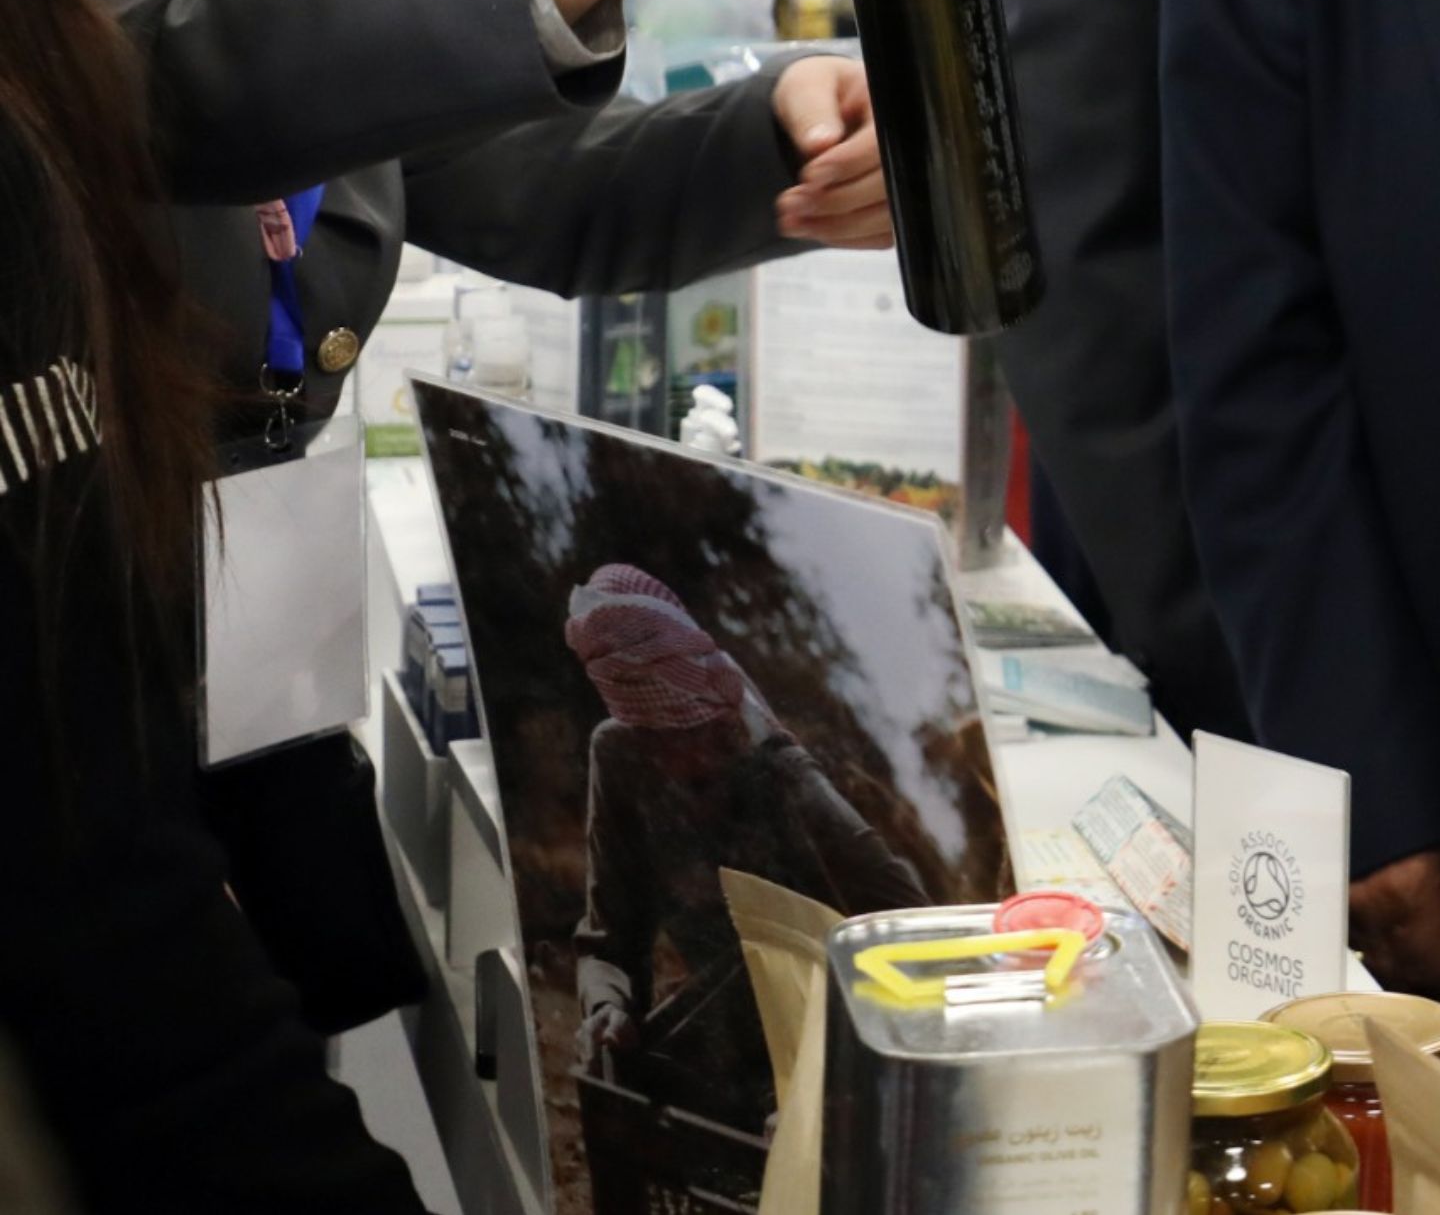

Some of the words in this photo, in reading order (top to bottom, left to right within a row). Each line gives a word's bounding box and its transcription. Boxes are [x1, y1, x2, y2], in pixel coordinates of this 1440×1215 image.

[1229, 855, 1242, 896] SOIL
[1240, 830, 1304, 916] ASSOCIATION
[1237, 904, 1294, 940] ORGANIC
[1228, 940, 1304, 980] COSMOS
[1228, 962, 1303, 999] ORGANIC
